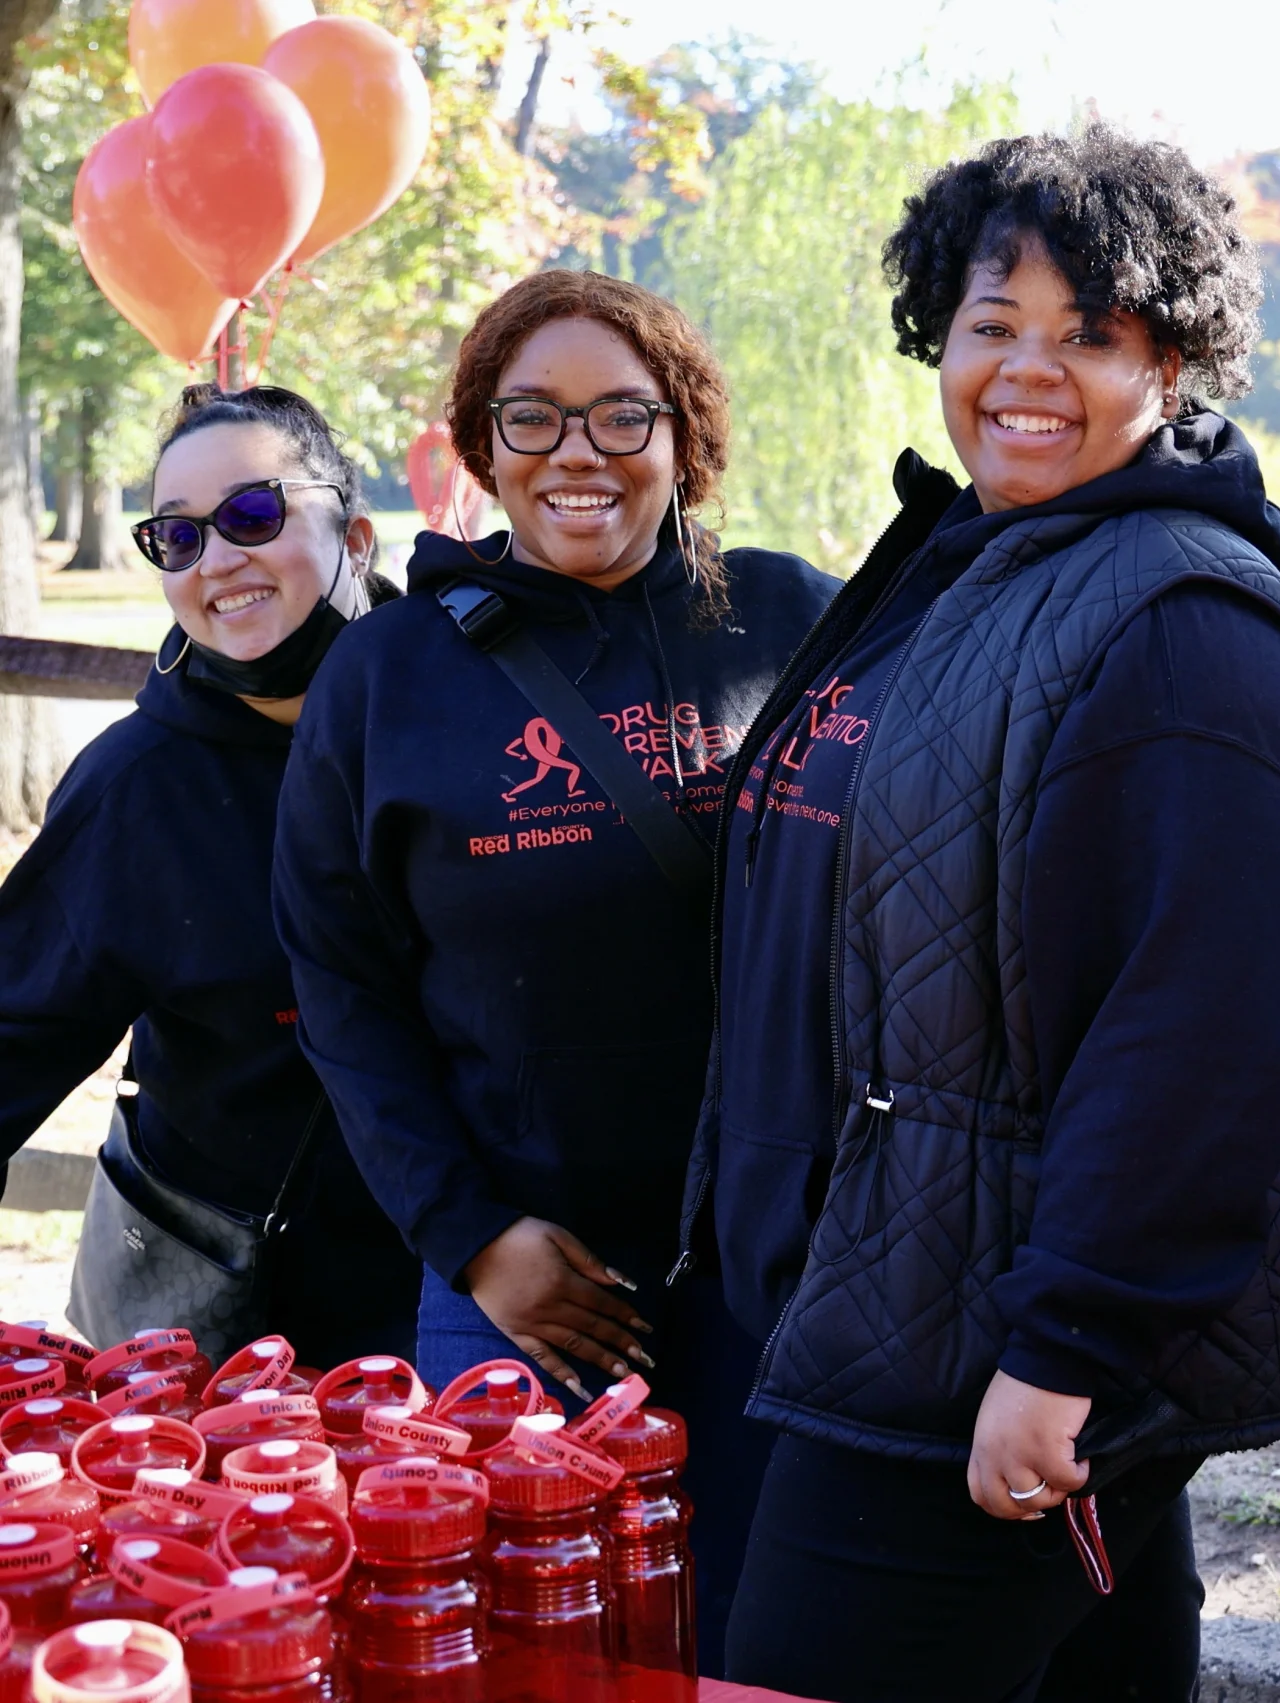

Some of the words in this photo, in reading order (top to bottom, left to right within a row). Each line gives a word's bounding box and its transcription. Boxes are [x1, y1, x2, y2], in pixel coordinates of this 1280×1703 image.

[624, 724, 751, 755] REVEN
[508, 799, 606, 822] #Everyone
[817, 810, 841, 828] one.
[469, 833, 510, 856] Red
[516, 826, 593, 850] Ribbon
[38, 1334, 66, 1350] Red
[276, 1349, 292, 1370] Day
[398, 1426, 452, 1450] County
[528, 1434, 566, 1460] Union
[569, 1455, 613, 1486] County
[233, 1479, 287, 1494] Ribbon
[171, 1490, 206, 1510] Day
